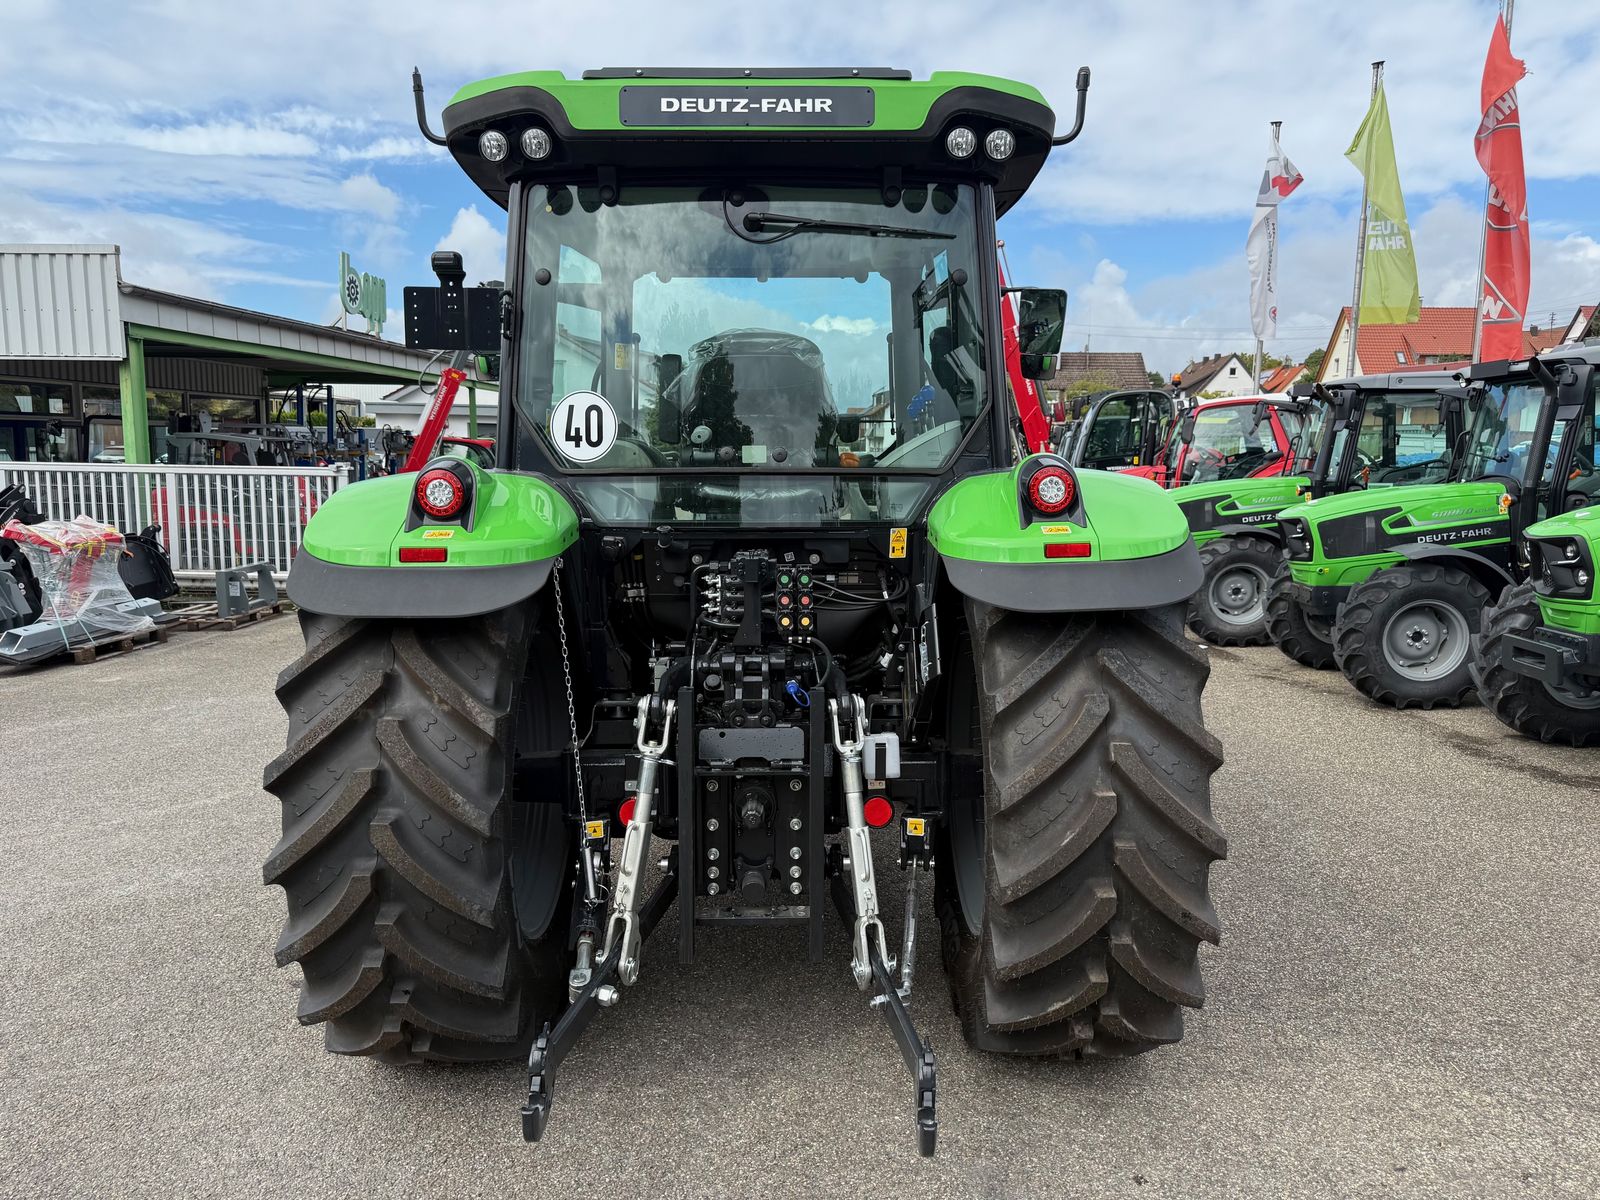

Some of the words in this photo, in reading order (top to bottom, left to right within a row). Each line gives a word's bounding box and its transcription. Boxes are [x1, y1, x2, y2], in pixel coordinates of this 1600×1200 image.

[660, 97, 833, 113] DEUTZ-FAHR
[428, 385, 448, 421] WEIDEMANN
[565, 404, 604, 449] 40
[1417, 527, 1492, 545] DEUTZ-FAHR
